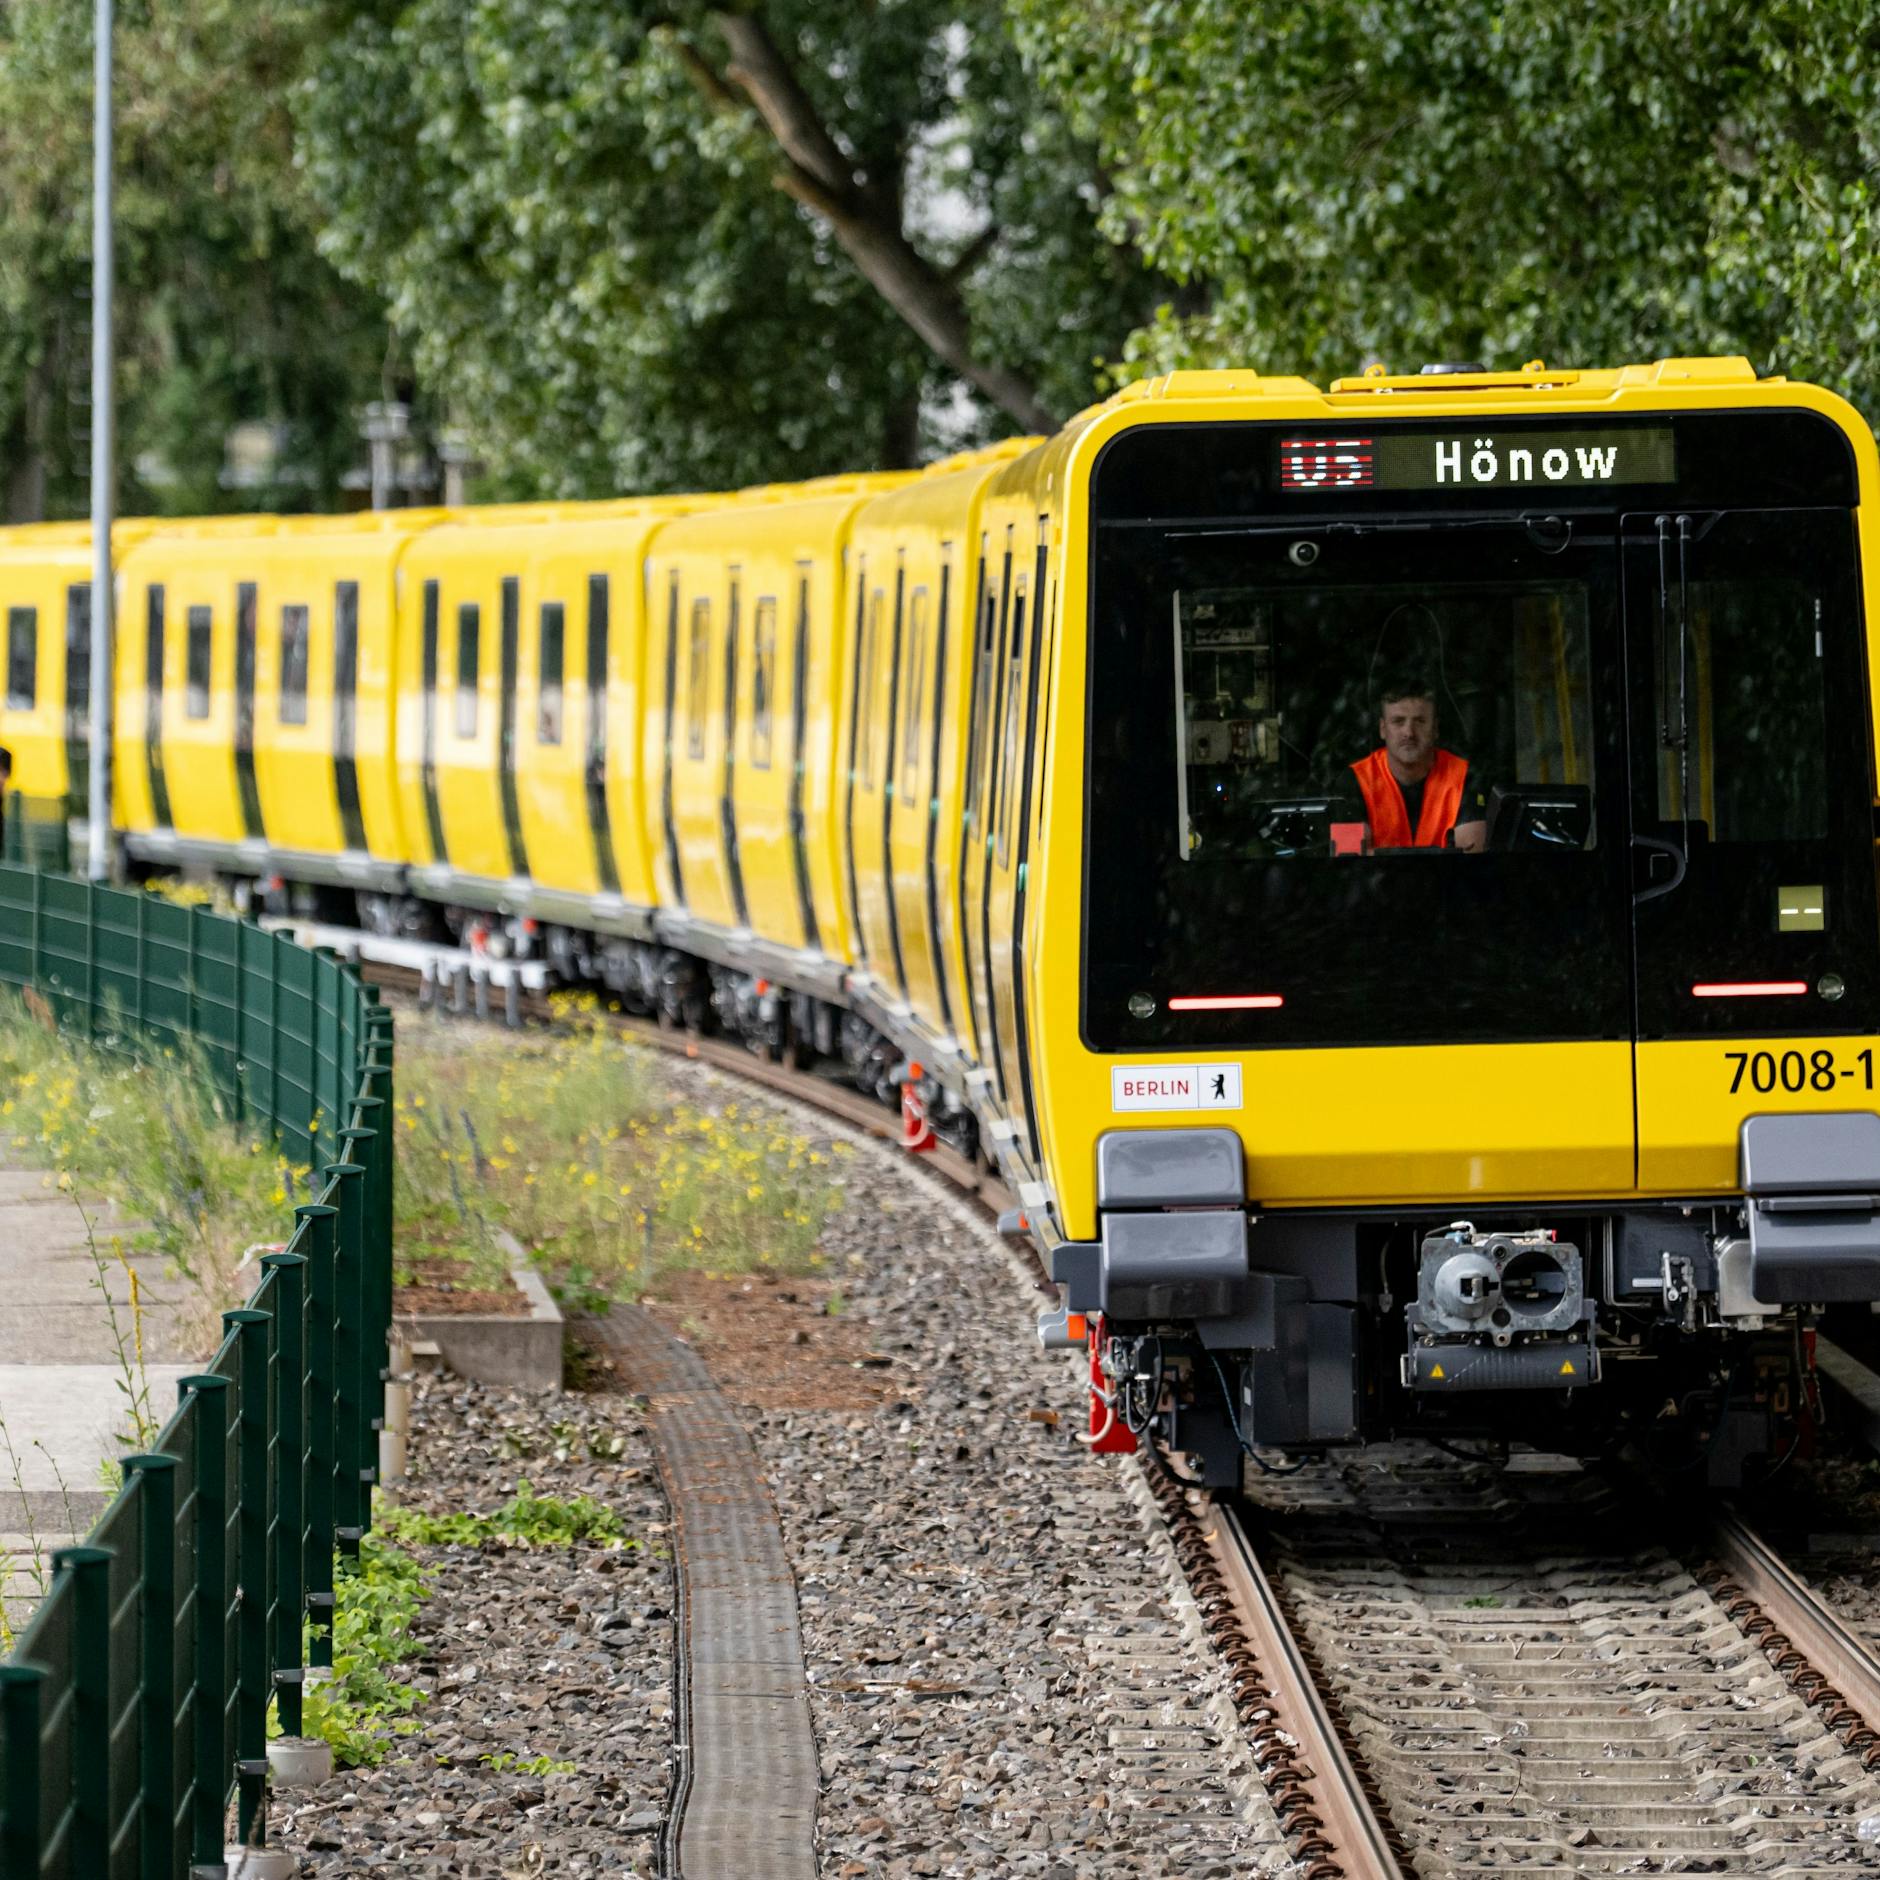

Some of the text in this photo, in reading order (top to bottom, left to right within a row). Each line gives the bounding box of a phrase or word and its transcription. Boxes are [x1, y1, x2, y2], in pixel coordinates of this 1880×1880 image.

[1435, 438, 1617, 483] Hönow
[1123, 1080, 1189, 1096] BERLIN
[1725, 1049, 1873, 1094] 7008-1
